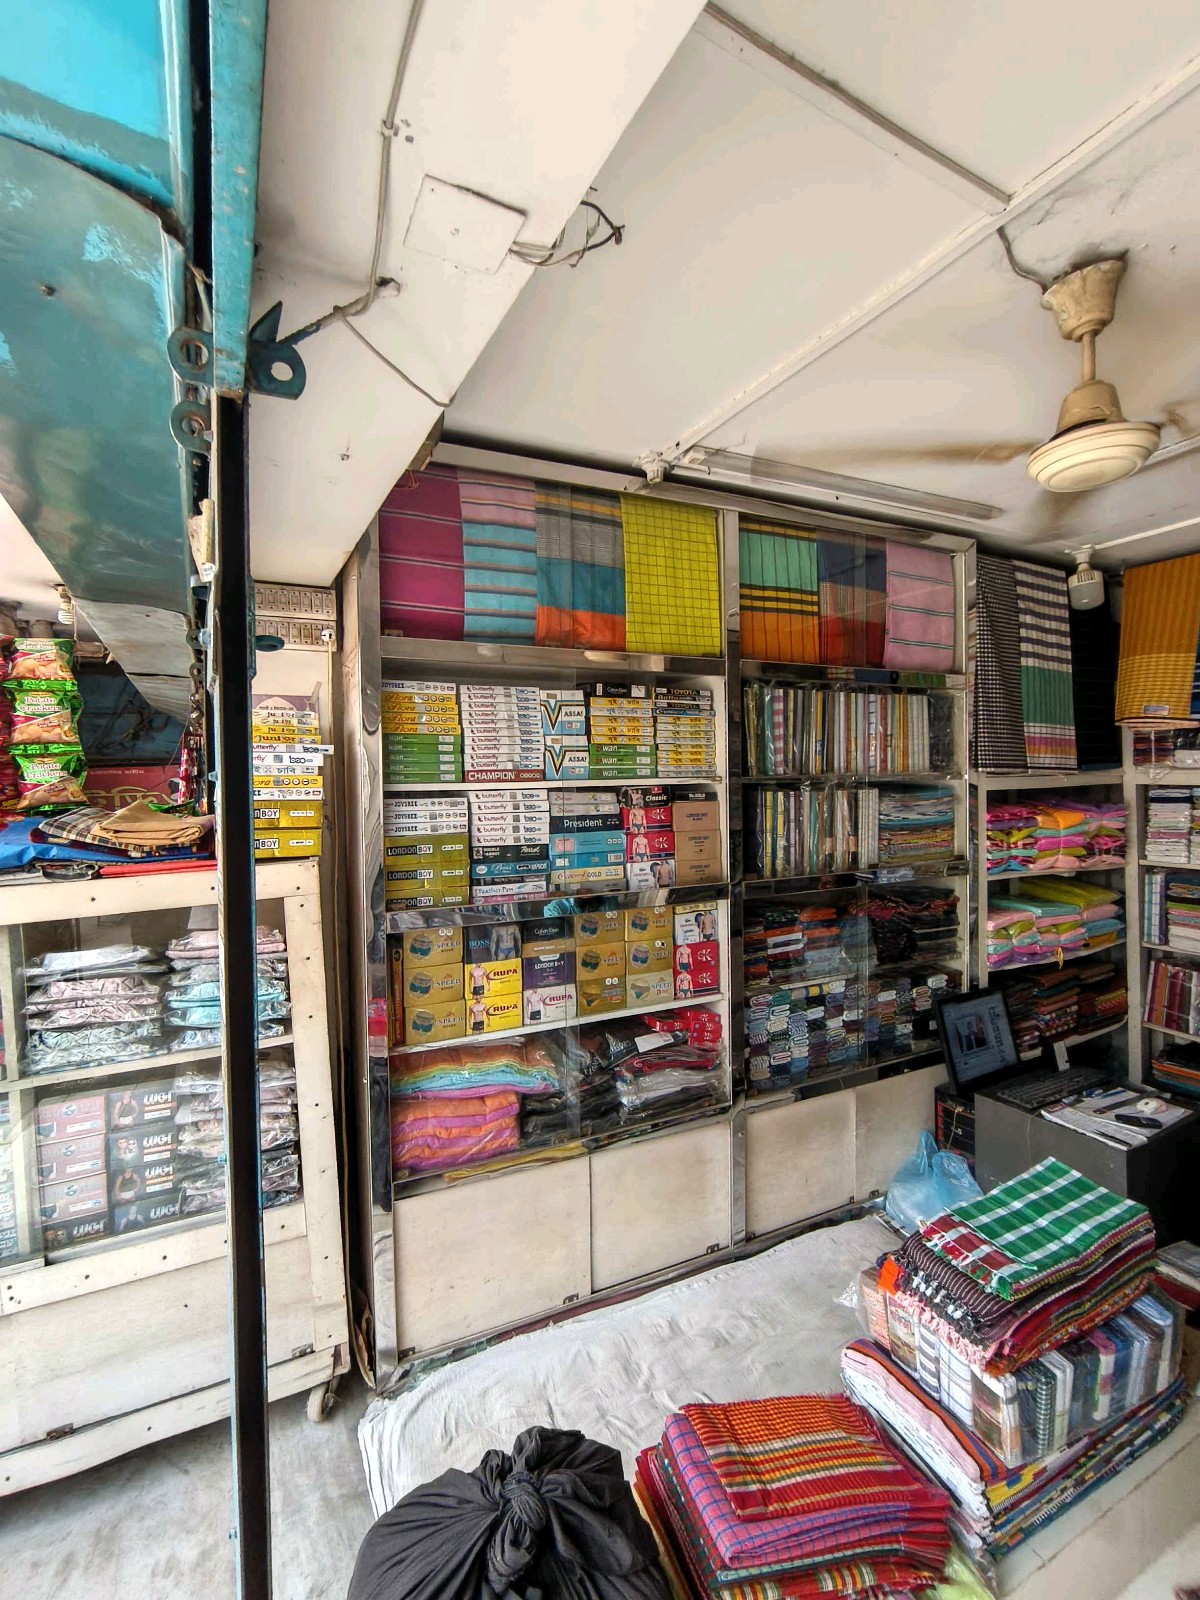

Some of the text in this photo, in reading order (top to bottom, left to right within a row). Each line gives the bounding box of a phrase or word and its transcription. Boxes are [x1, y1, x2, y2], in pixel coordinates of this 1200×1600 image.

[472, 685, 495, 693] butterfly
[25, 696, 56, 704] Potato
[19, 704, 62, 712] Crackers
[474, 702, 497, 710] butterfly
[475, 711, 497, 719] butterfly
[474, 719, 497, 727] butterfly
[476, 728, 499, 736] butterfly
[477, 737, 501, 745] butterfly
[475, 754, 499, 762] butterfly
[476, 762, 499, 770] butterfly
[26, 770, 68, 779] Crackers
[468, 771, 515, 780] CHAMPION
[482, 792, 505, 800] butterfly
[645, 793, 668, 802] Classic
[484, 803, 507, 811] butterfly
[484, 814, 508, 823] butterfly
[563, 819, 603, 828] President
[483, 826, 507, 834] butterfly
[261, 840, 277, 848] BOY
[483, 836, 507, 844] butterfly
[417, 845, 432, 854] BOY
[418, 870, 432, 878] BOY
[587, 871, 602, 879] GOLD
[478, 887, 502, 895] Feather
[418, 897, 432, 906] BOY
[436, 941, 461, 949] SPEED
[468, 939, 490, 948] BOSS
[493, 968, 518, 977] RUPA
[436, 978, 461, 986] SPEED
[549, 993, 573, 1002] RUPA
[493, 1003, 519, 1013] RUPA
[438, 1016, 463, 1025] SPEED
